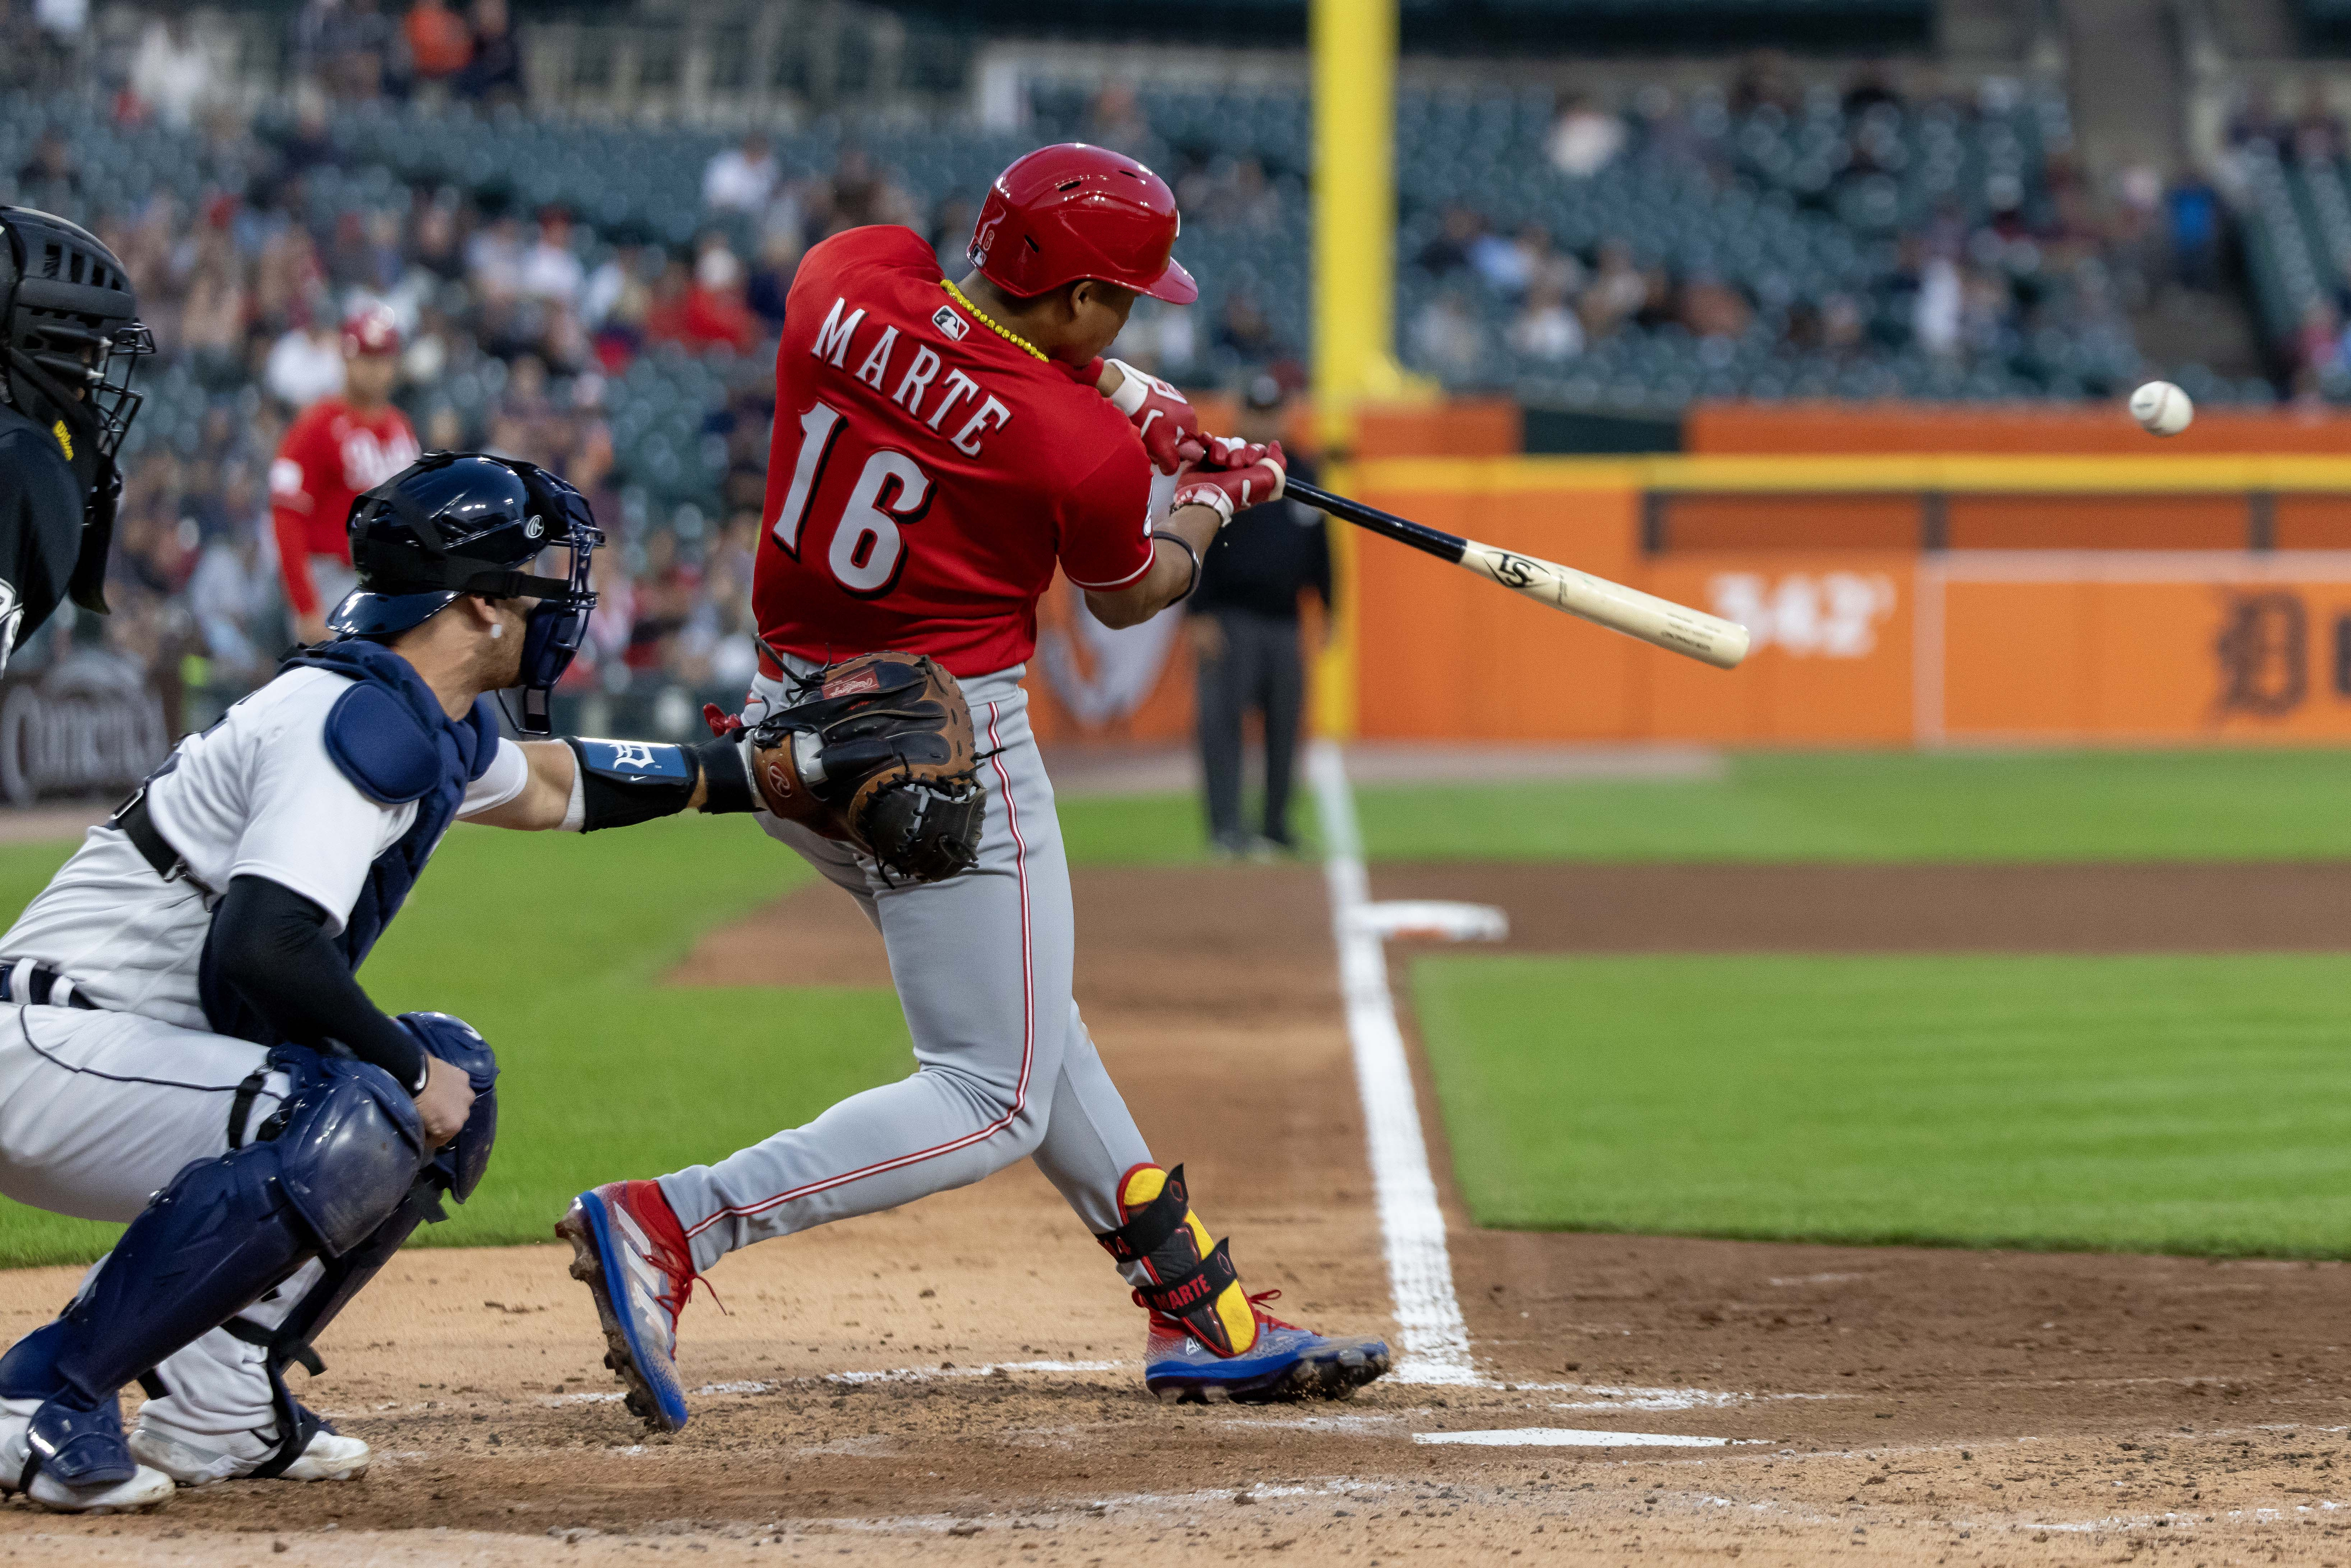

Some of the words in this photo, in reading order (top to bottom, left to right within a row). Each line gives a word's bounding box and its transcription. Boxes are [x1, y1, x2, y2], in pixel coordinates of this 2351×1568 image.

[811, 296, 1012, 458] MARTE
[772, 398, 936, 597] 16
[608, 744, 656, 769] D
[1152, 1273, 1212, 1310] MARTE
